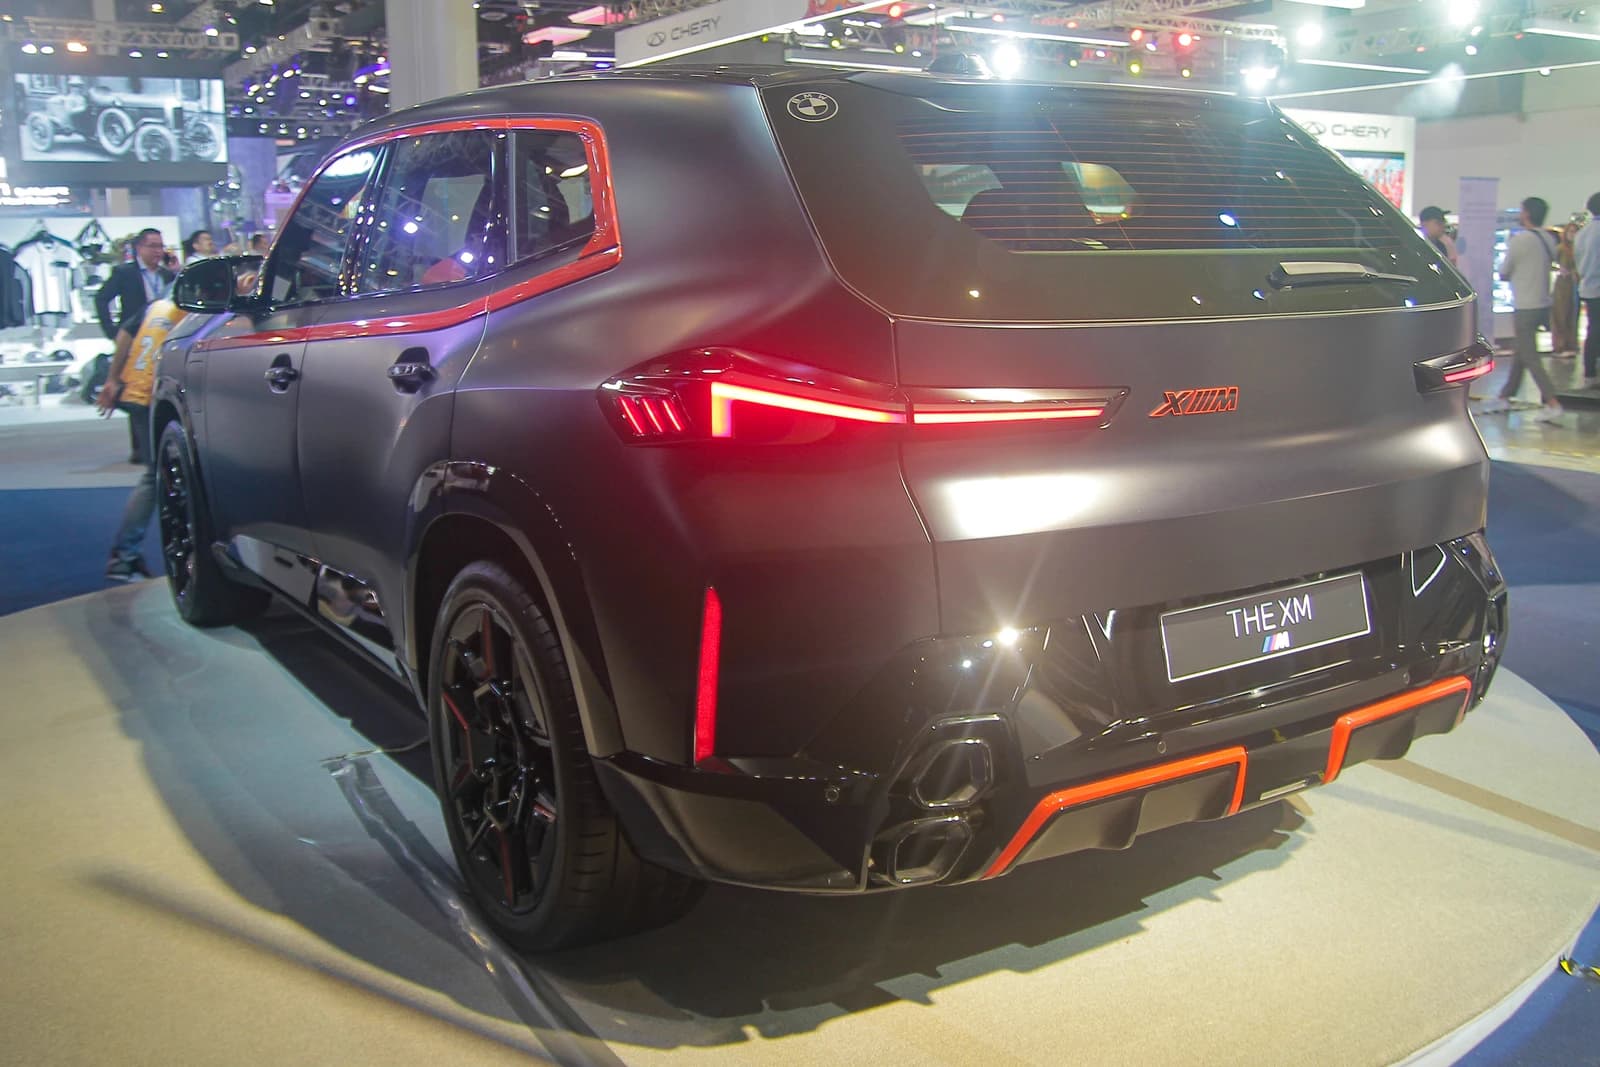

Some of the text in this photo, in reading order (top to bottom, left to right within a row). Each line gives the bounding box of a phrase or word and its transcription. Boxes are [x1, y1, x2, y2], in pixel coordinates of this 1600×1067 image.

[671, 16, 720, 40] CHERY
[1331, 124, 1391, 138] CHERY
[1226, 594, 1312, 637] THE XM
